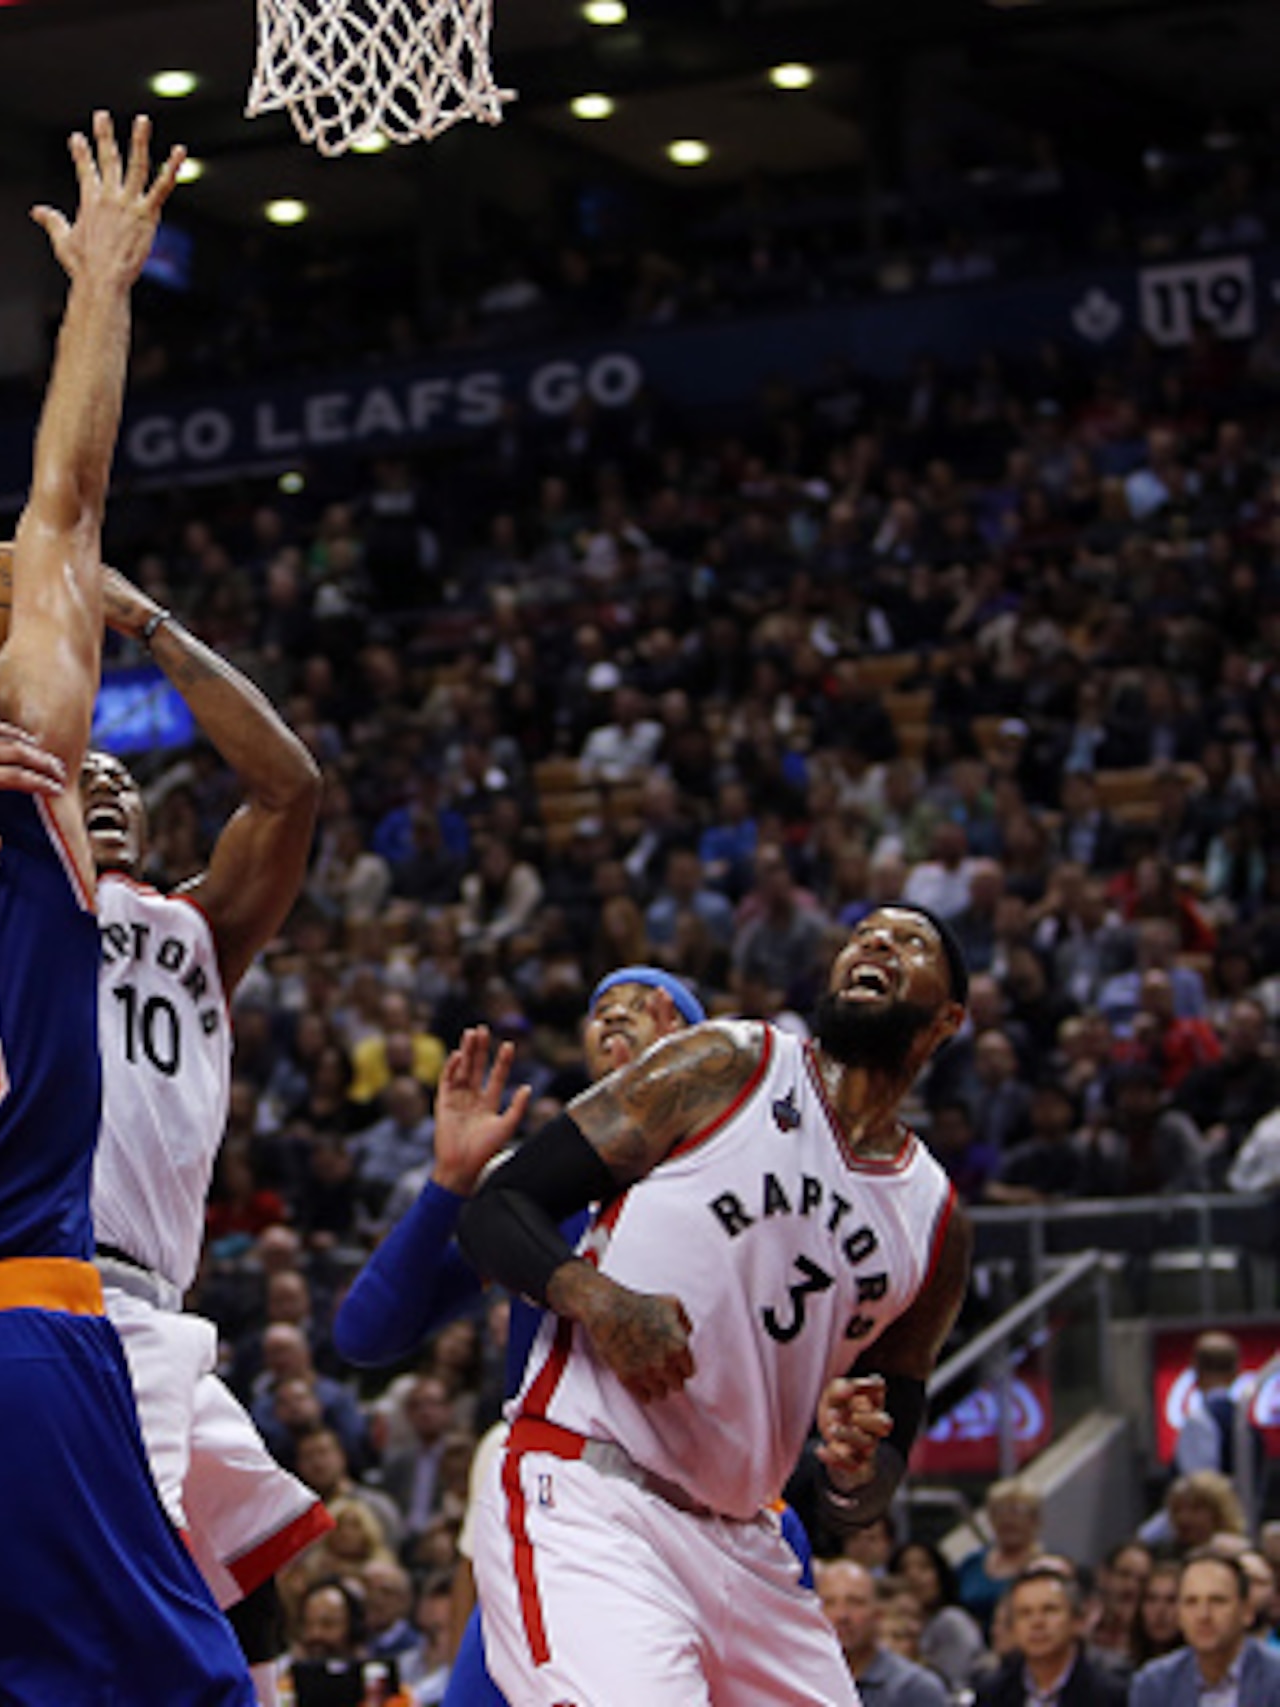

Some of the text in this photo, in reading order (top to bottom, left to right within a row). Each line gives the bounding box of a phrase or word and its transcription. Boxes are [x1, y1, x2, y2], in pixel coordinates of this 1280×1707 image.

[1152, 272, 1244, 332] 119
[128, 353, 642, 466] GO LEAFS GO
[112, 983, 181, 1077] 10
[709, 1171, 890, 1341] RAPTORS
[762, 1254, 835, 1344] 3
